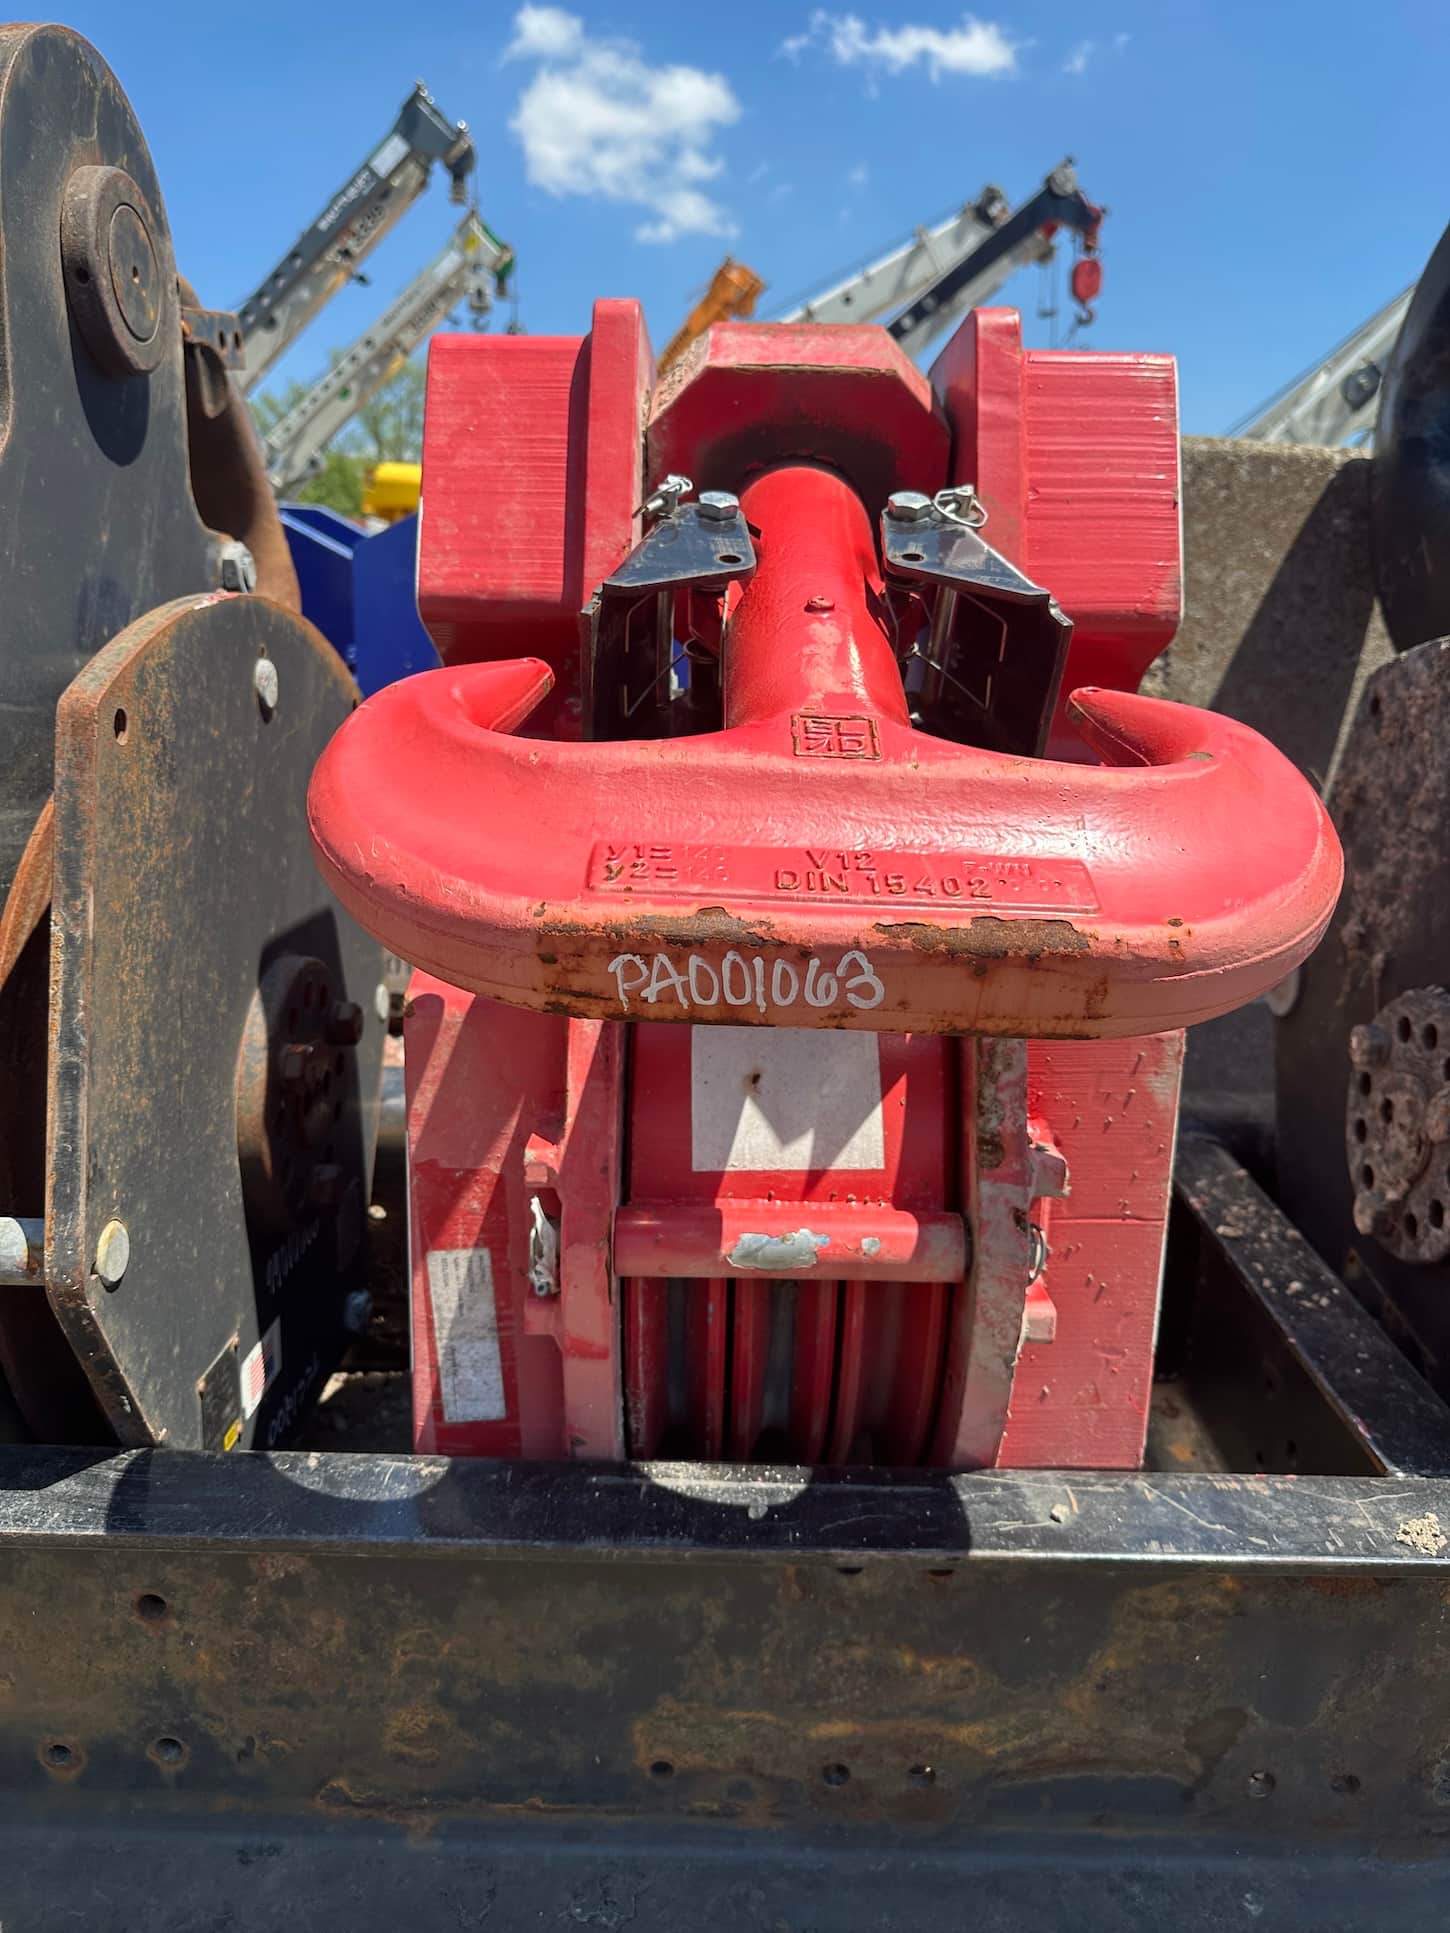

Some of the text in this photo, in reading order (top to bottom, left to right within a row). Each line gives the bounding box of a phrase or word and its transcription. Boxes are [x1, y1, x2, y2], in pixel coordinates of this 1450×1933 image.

[805, 850, 877, 872] V12
[775, 868, 849, 893] DIN
[866, 872, 993, 899] 15402
[607, 950, 885, 1013] PA001063
